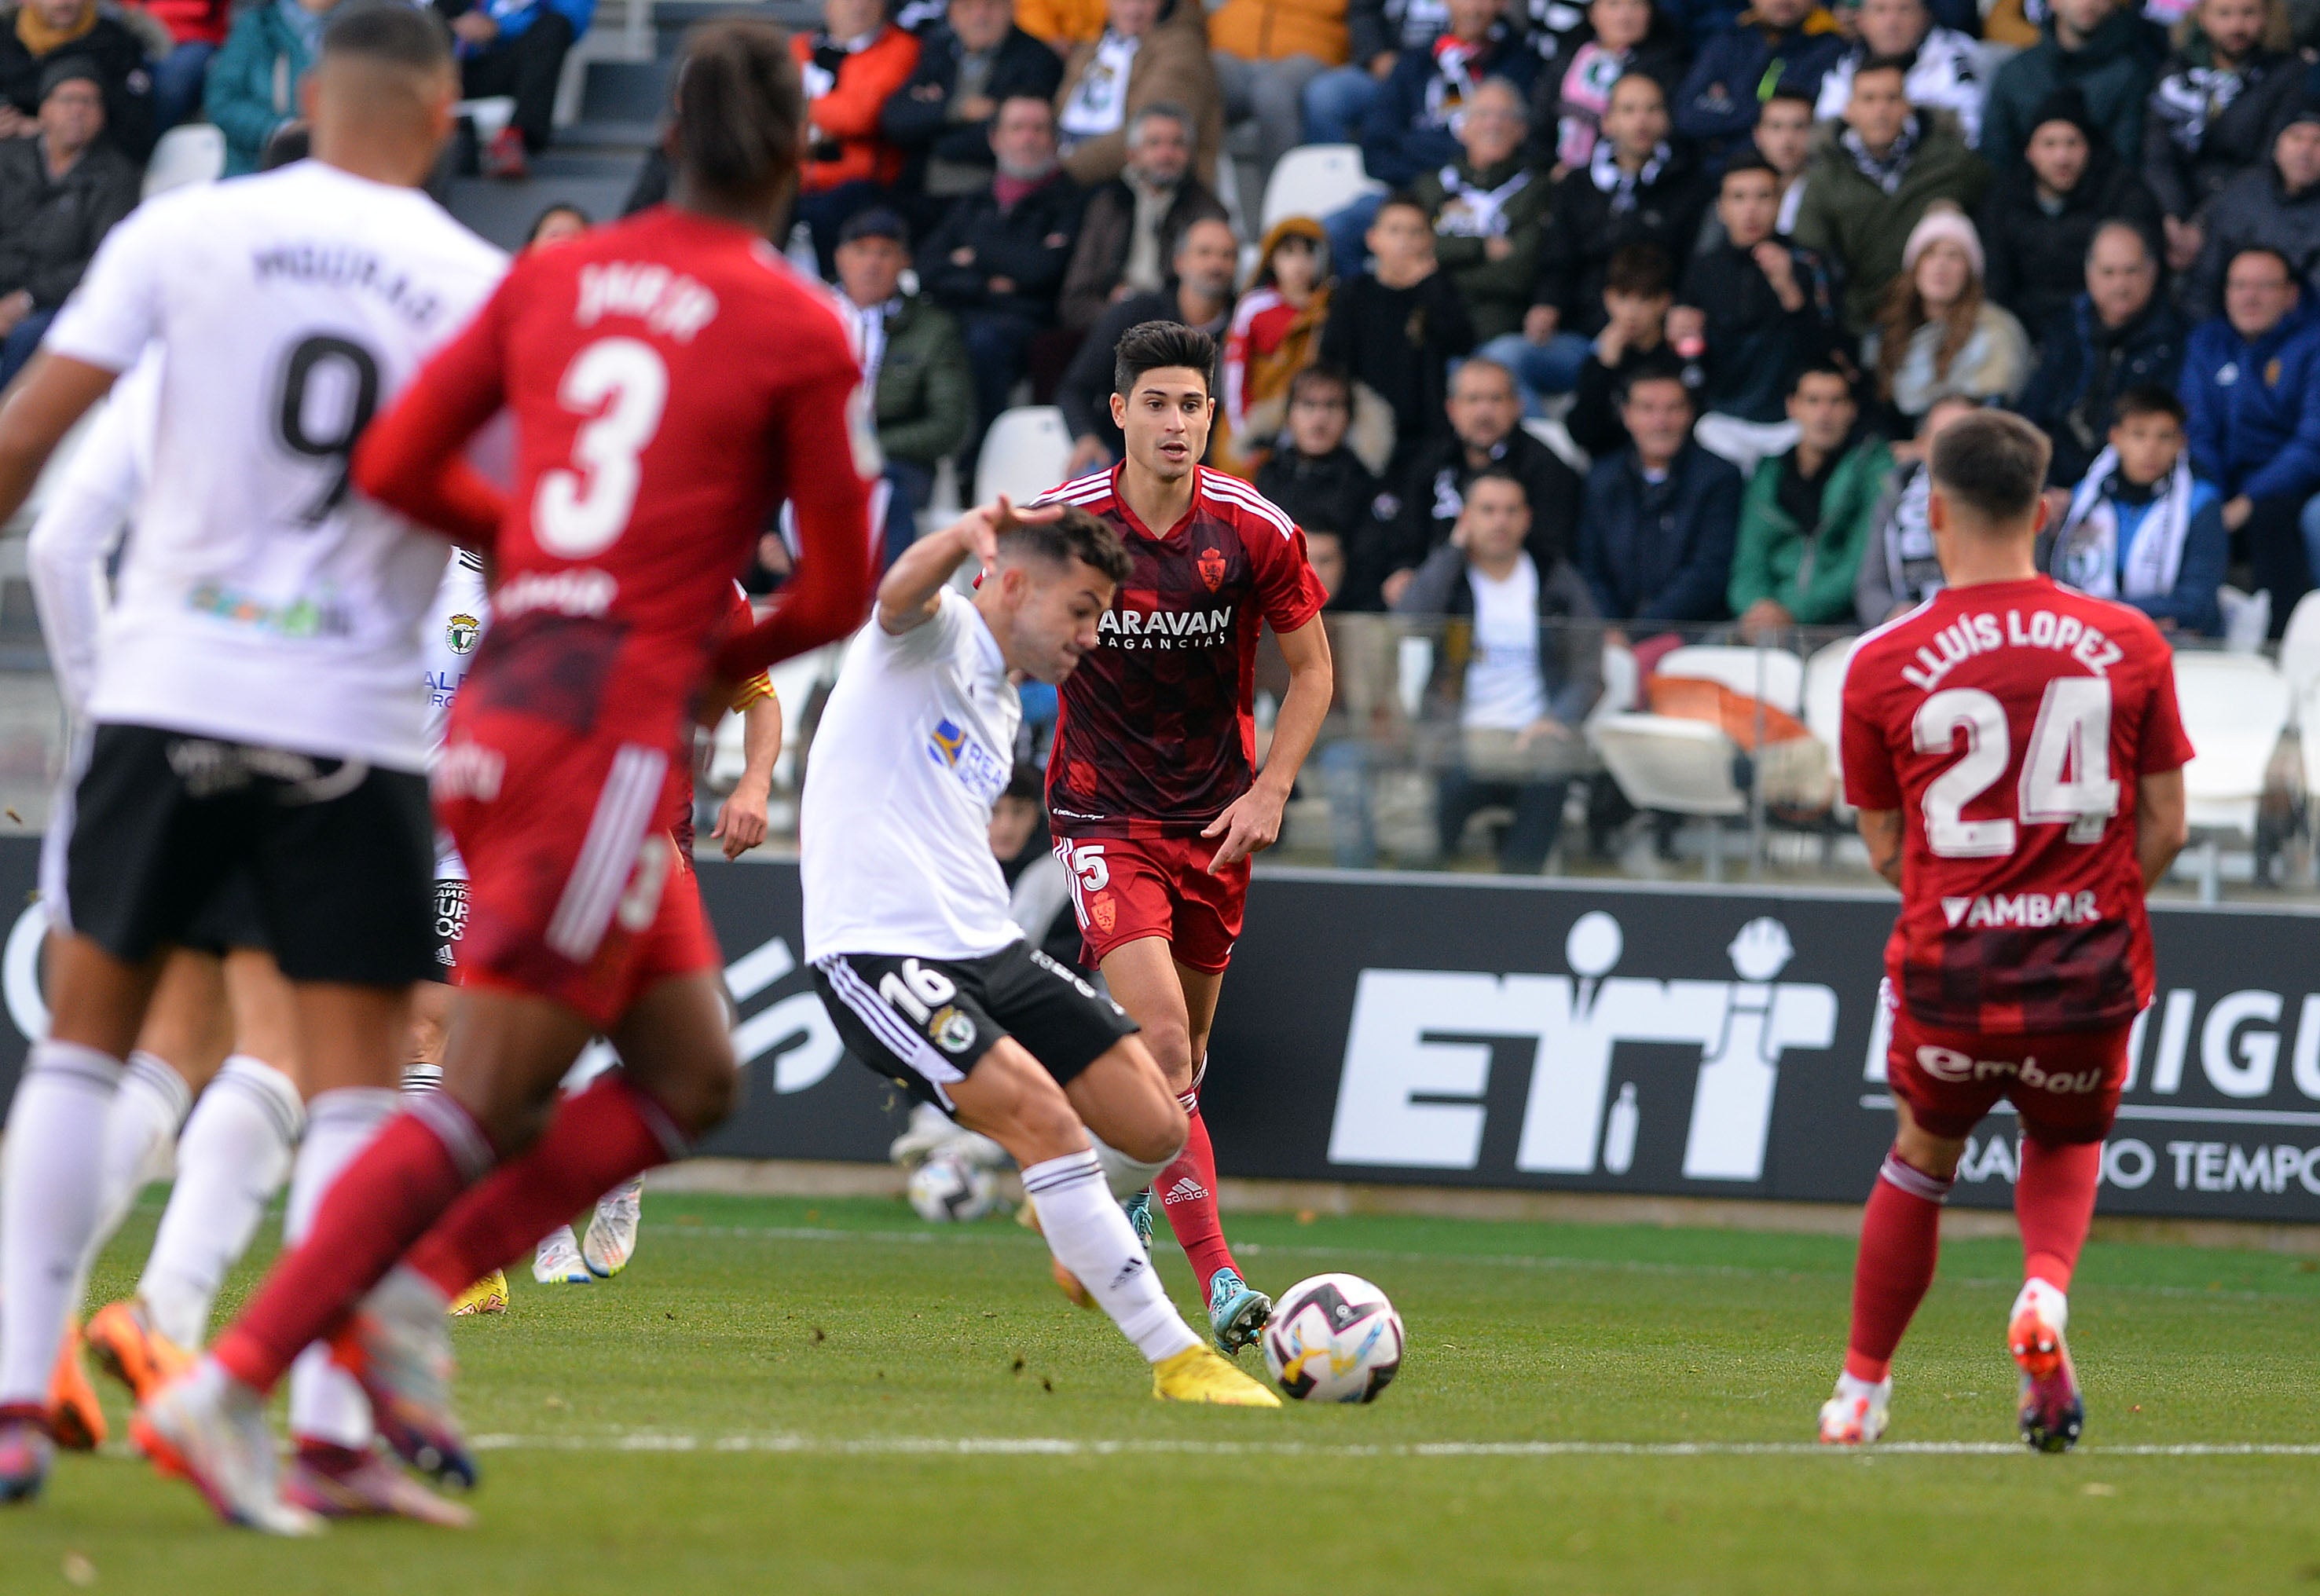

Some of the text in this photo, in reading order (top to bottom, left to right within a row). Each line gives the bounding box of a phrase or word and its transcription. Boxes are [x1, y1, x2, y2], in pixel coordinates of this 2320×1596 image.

[279, 326, 382, 525] 9
[531, 334, 672, 560] 3
[1094, 631, 1226, 650] RAGANCIAS
[1097, 606, 1232, 635] ARAVAN
[2005, 609, 2124, 677] LOPEZ
[1911, 675, 2121, 858] 24
[1072, 844, 1110, 892] 5
[1966, 889, 2102, 928] AMBAR
[878, 957, 957, 1026] 16
[1915, 1045, 2103, 1095] embou
[1164, 1188, 1210, 1206] adidas
